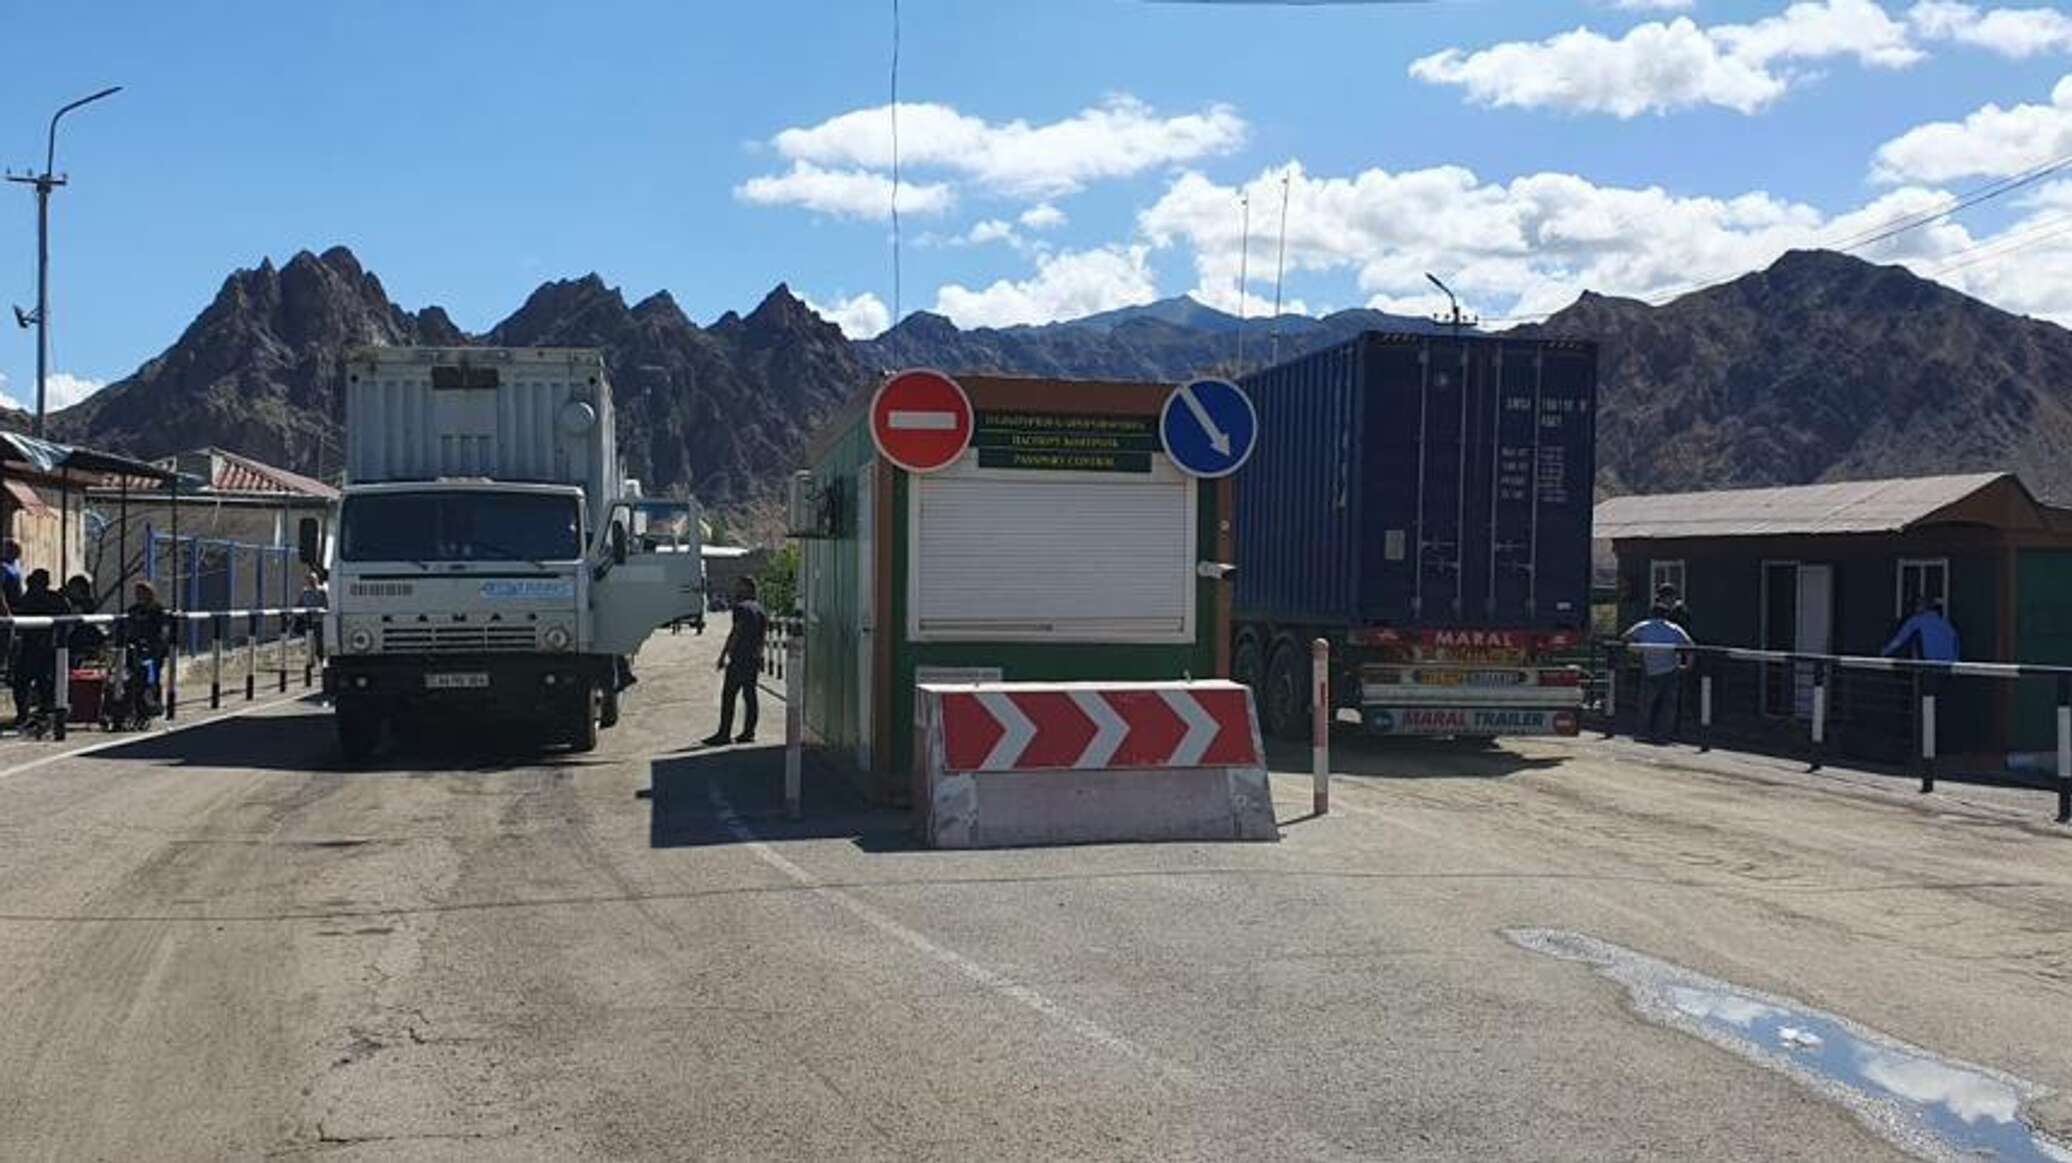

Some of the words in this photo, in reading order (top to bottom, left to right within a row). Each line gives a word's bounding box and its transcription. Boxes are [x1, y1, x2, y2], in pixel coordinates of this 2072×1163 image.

[1434, 631, 1514, 647] MARAL
[1402, 710, 1466, 727] MARAL
[1473, 712, 1545, 728] TRAILER
